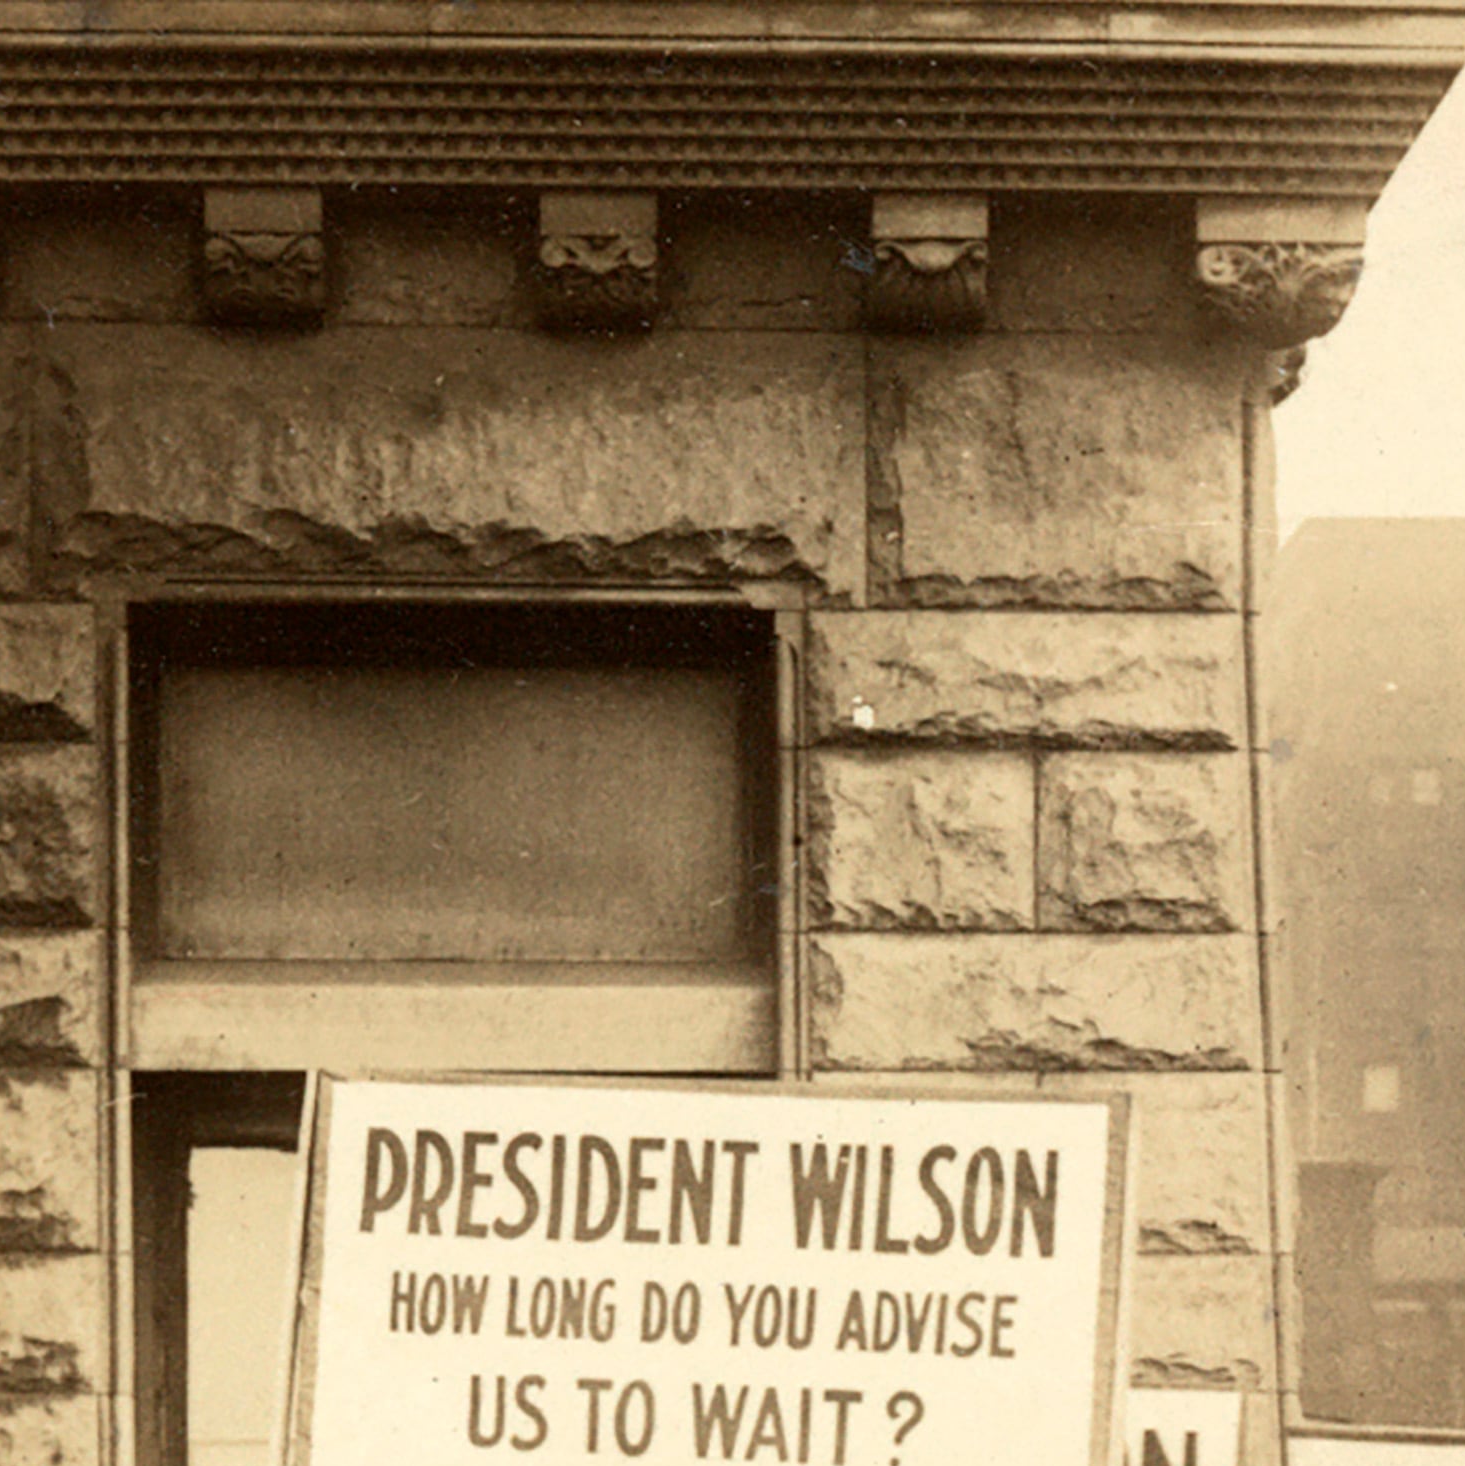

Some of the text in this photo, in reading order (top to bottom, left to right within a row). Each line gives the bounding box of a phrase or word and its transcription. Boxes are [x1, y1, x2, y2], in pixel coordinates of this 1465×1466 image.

[359, 1127, 1059, 1259] PRESIDENT WILSON
[389, 1270, 1019, 1358] HOW LONG DO YOU ADVISE
[467, 1374, 549, 1452] US
[577, 1378, 656, 1457] TO
